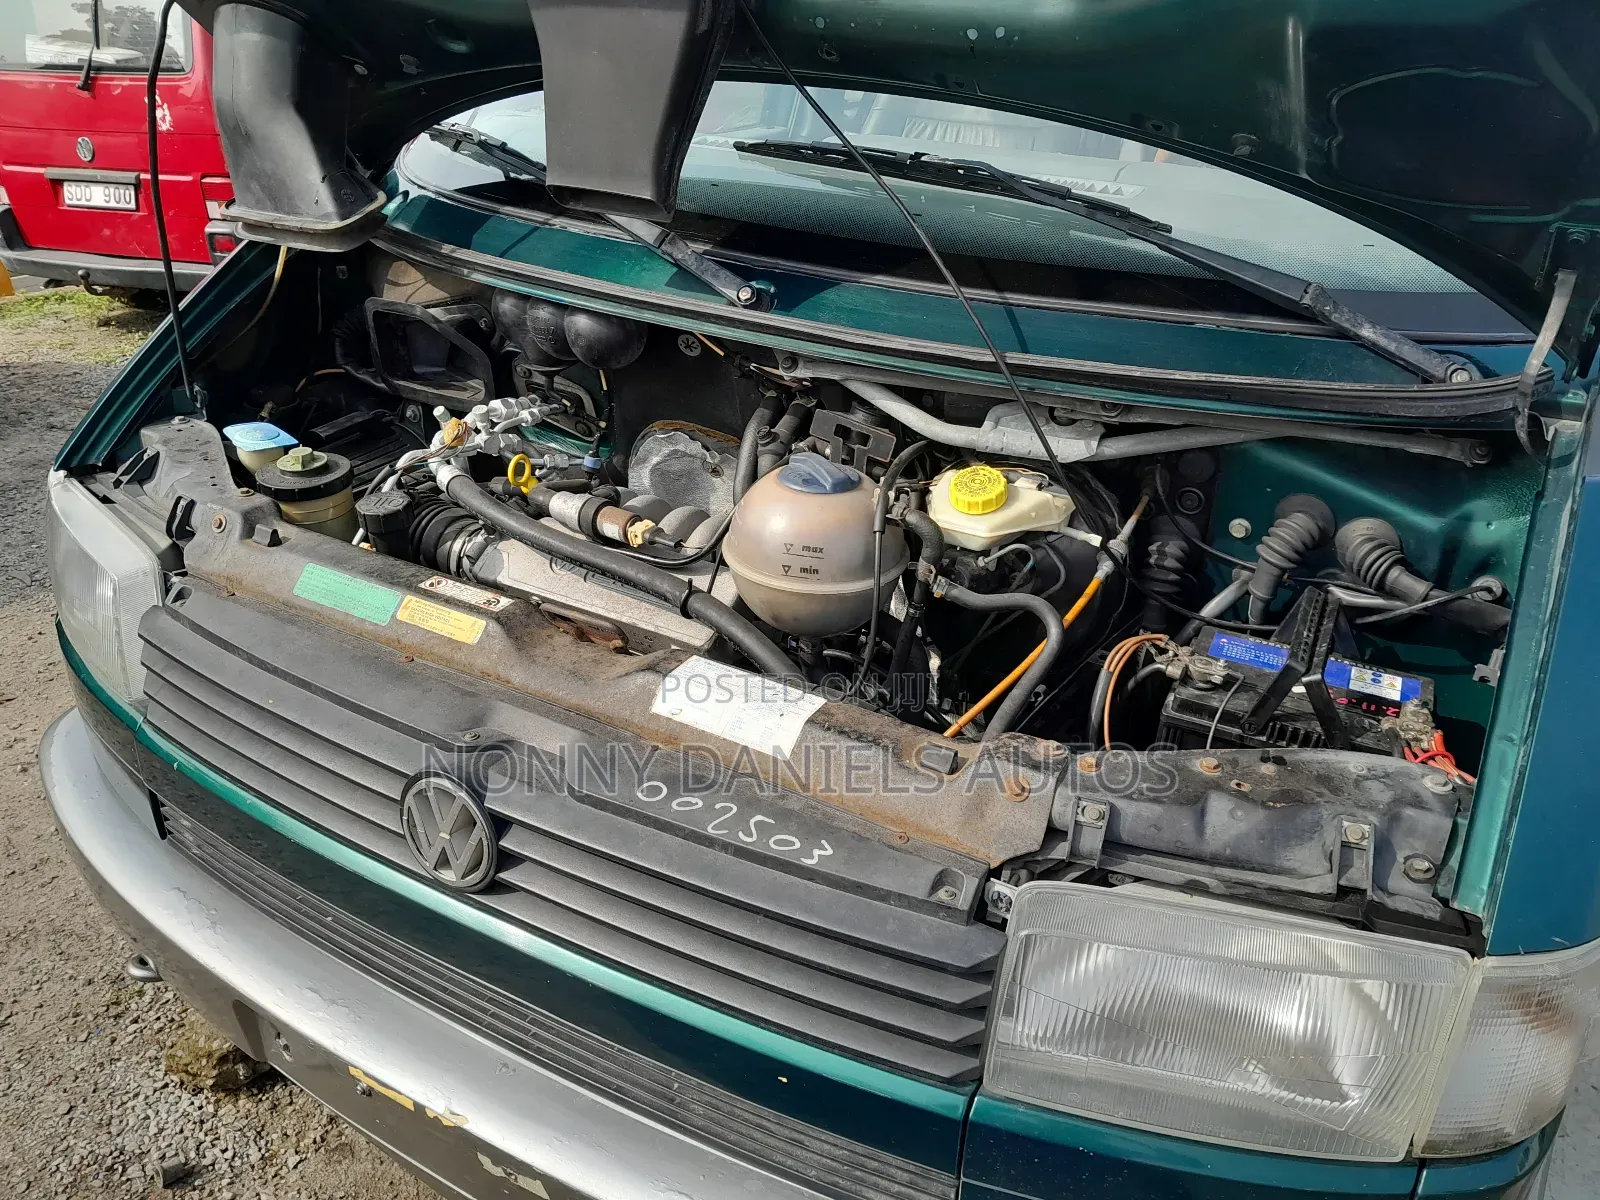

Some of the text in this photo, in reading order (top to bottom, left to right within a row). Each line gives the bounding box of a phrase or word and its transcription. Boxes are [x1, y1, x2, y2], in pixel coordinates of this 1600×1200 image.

[66, 184, 132, 205] SDD 900
[801, 545, 824, 554] max
[799, 565, 819, 575] min
[636, 781, 834, 865] 002503
